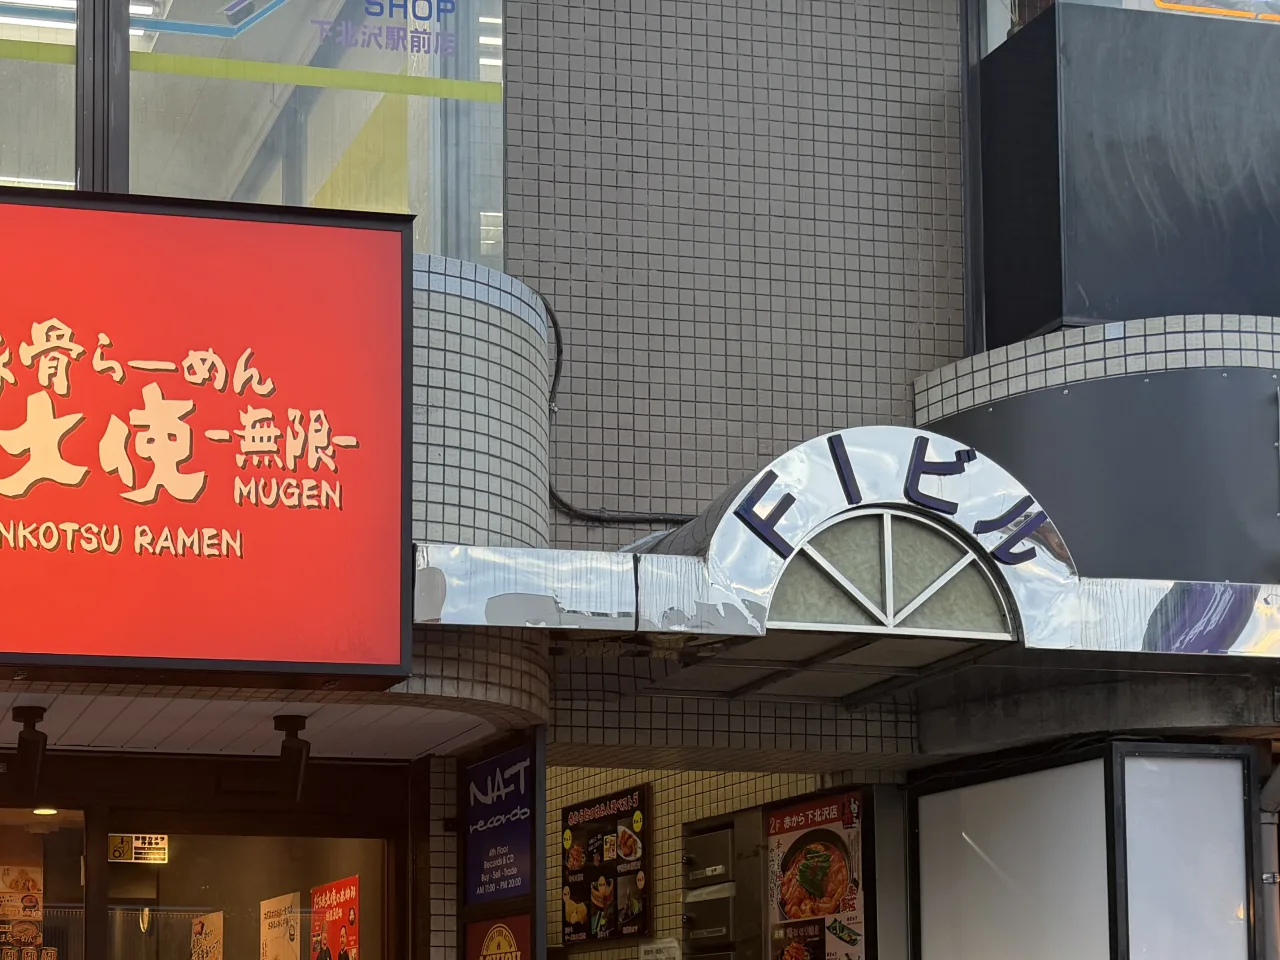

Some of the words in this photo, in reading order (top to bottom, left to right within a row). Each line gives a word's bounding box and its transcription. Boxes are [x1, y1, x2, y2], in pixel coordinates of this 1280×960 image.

[364, 0, 456, 22] SHOP
[310, 19, 456, 56] 下北沢駅前店
[233, 475, 344, 511] MUGEN
[133, 521, 244, 559] RAMEN
[469, 805, 531, 835] records
[769, 817, 781, 833] 2F
[783, 813, 805, 829] 赤から
[806, 804, 839, 824] 下北沢店
